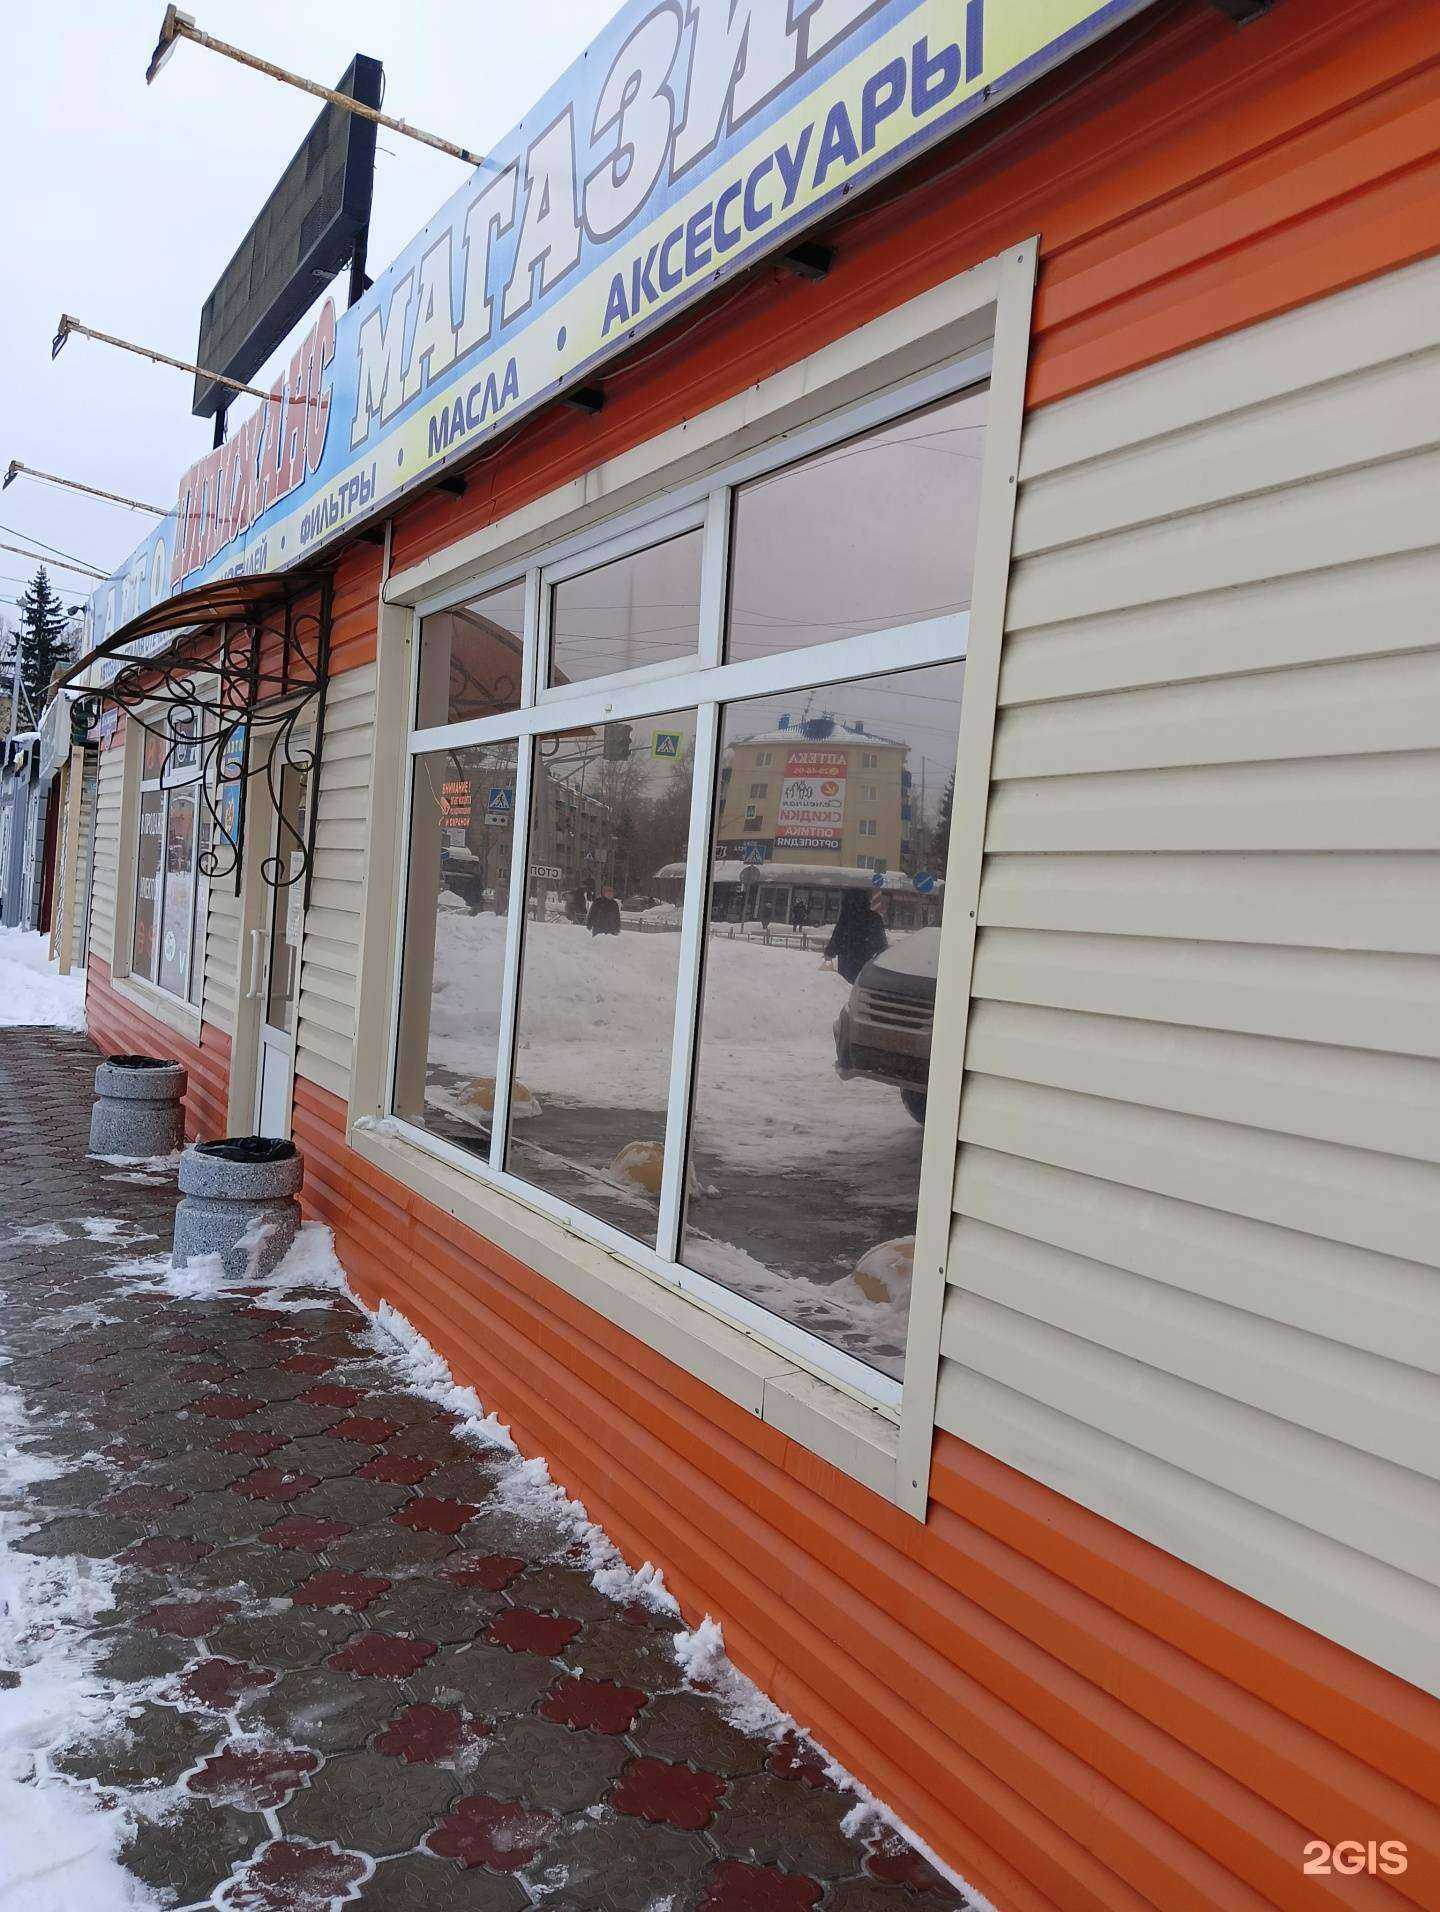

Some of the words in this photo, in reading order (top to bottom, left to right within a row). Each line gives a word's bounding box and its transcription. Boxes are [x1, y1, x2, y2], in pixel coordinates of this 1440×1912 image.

[300, 462, 376, 544] ФИЛЬТРЫ
[428, 357, 519, 457] МАСЛА
[601, 0, 984, 338] АКСЕССУАРЫ
[350, 0, 893, 448] МАГАЗИ
